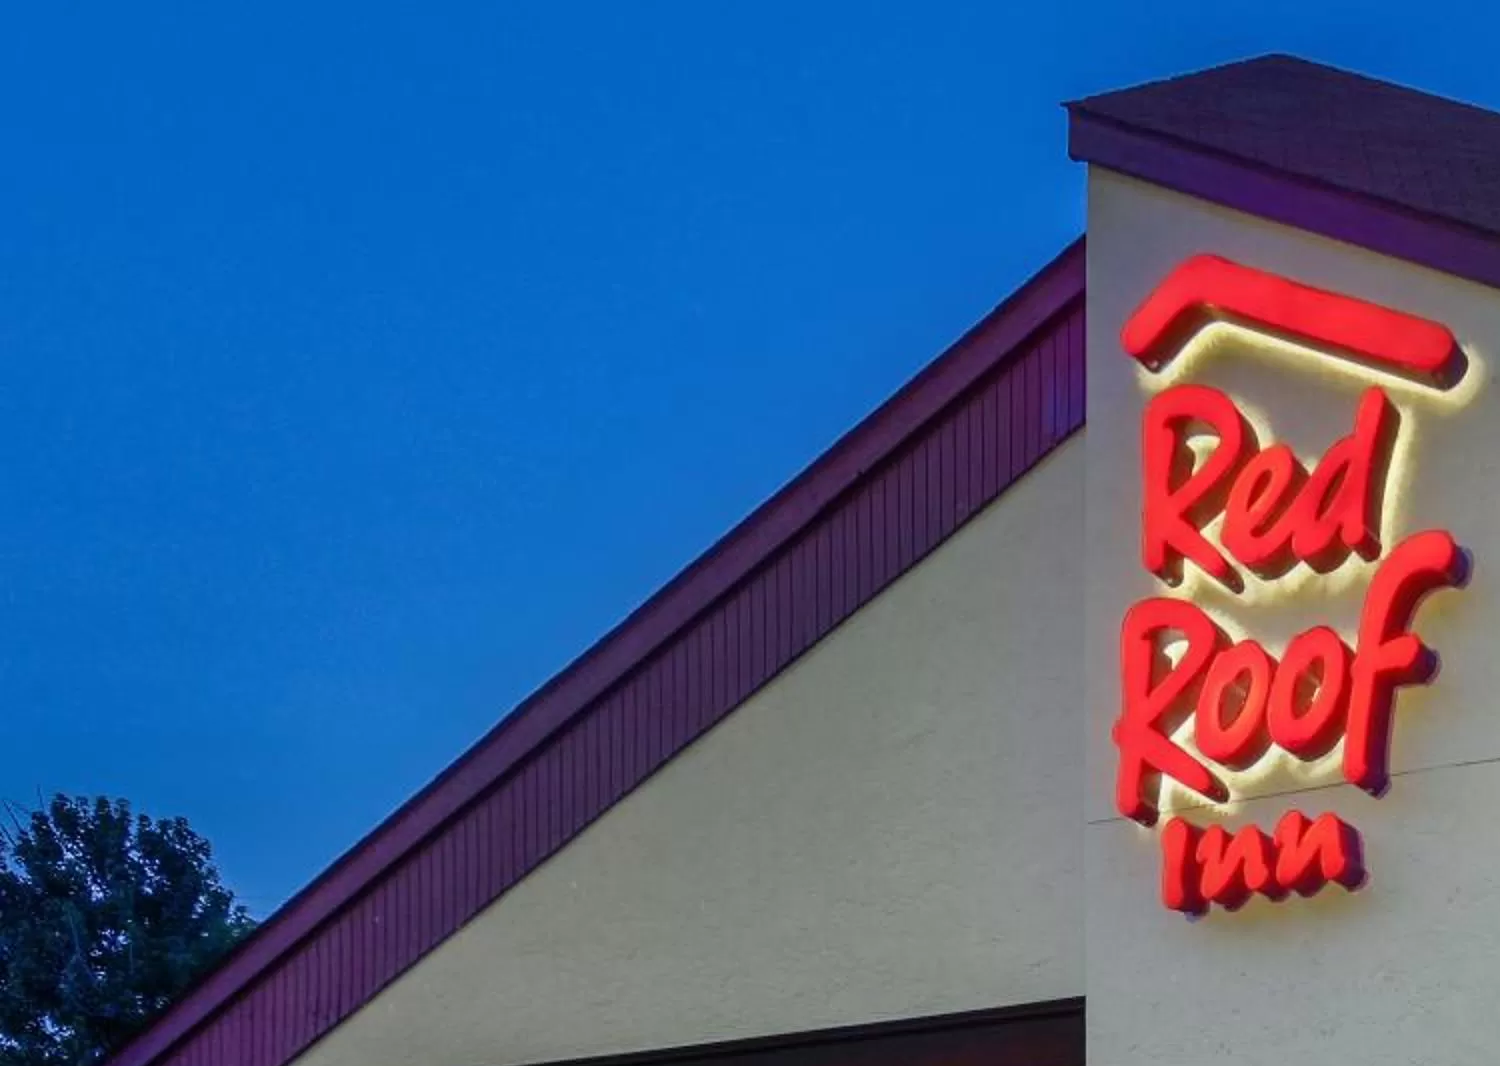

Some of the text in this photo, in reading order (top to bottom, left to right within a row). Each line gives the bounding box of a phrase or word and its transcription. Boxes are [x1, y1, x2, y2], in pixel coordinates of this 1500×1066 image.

[1141, 383, 1401, 594] Red
[1112, 529, 1467, 826] Roof
[1161, 809, 1366, 914] Inn
